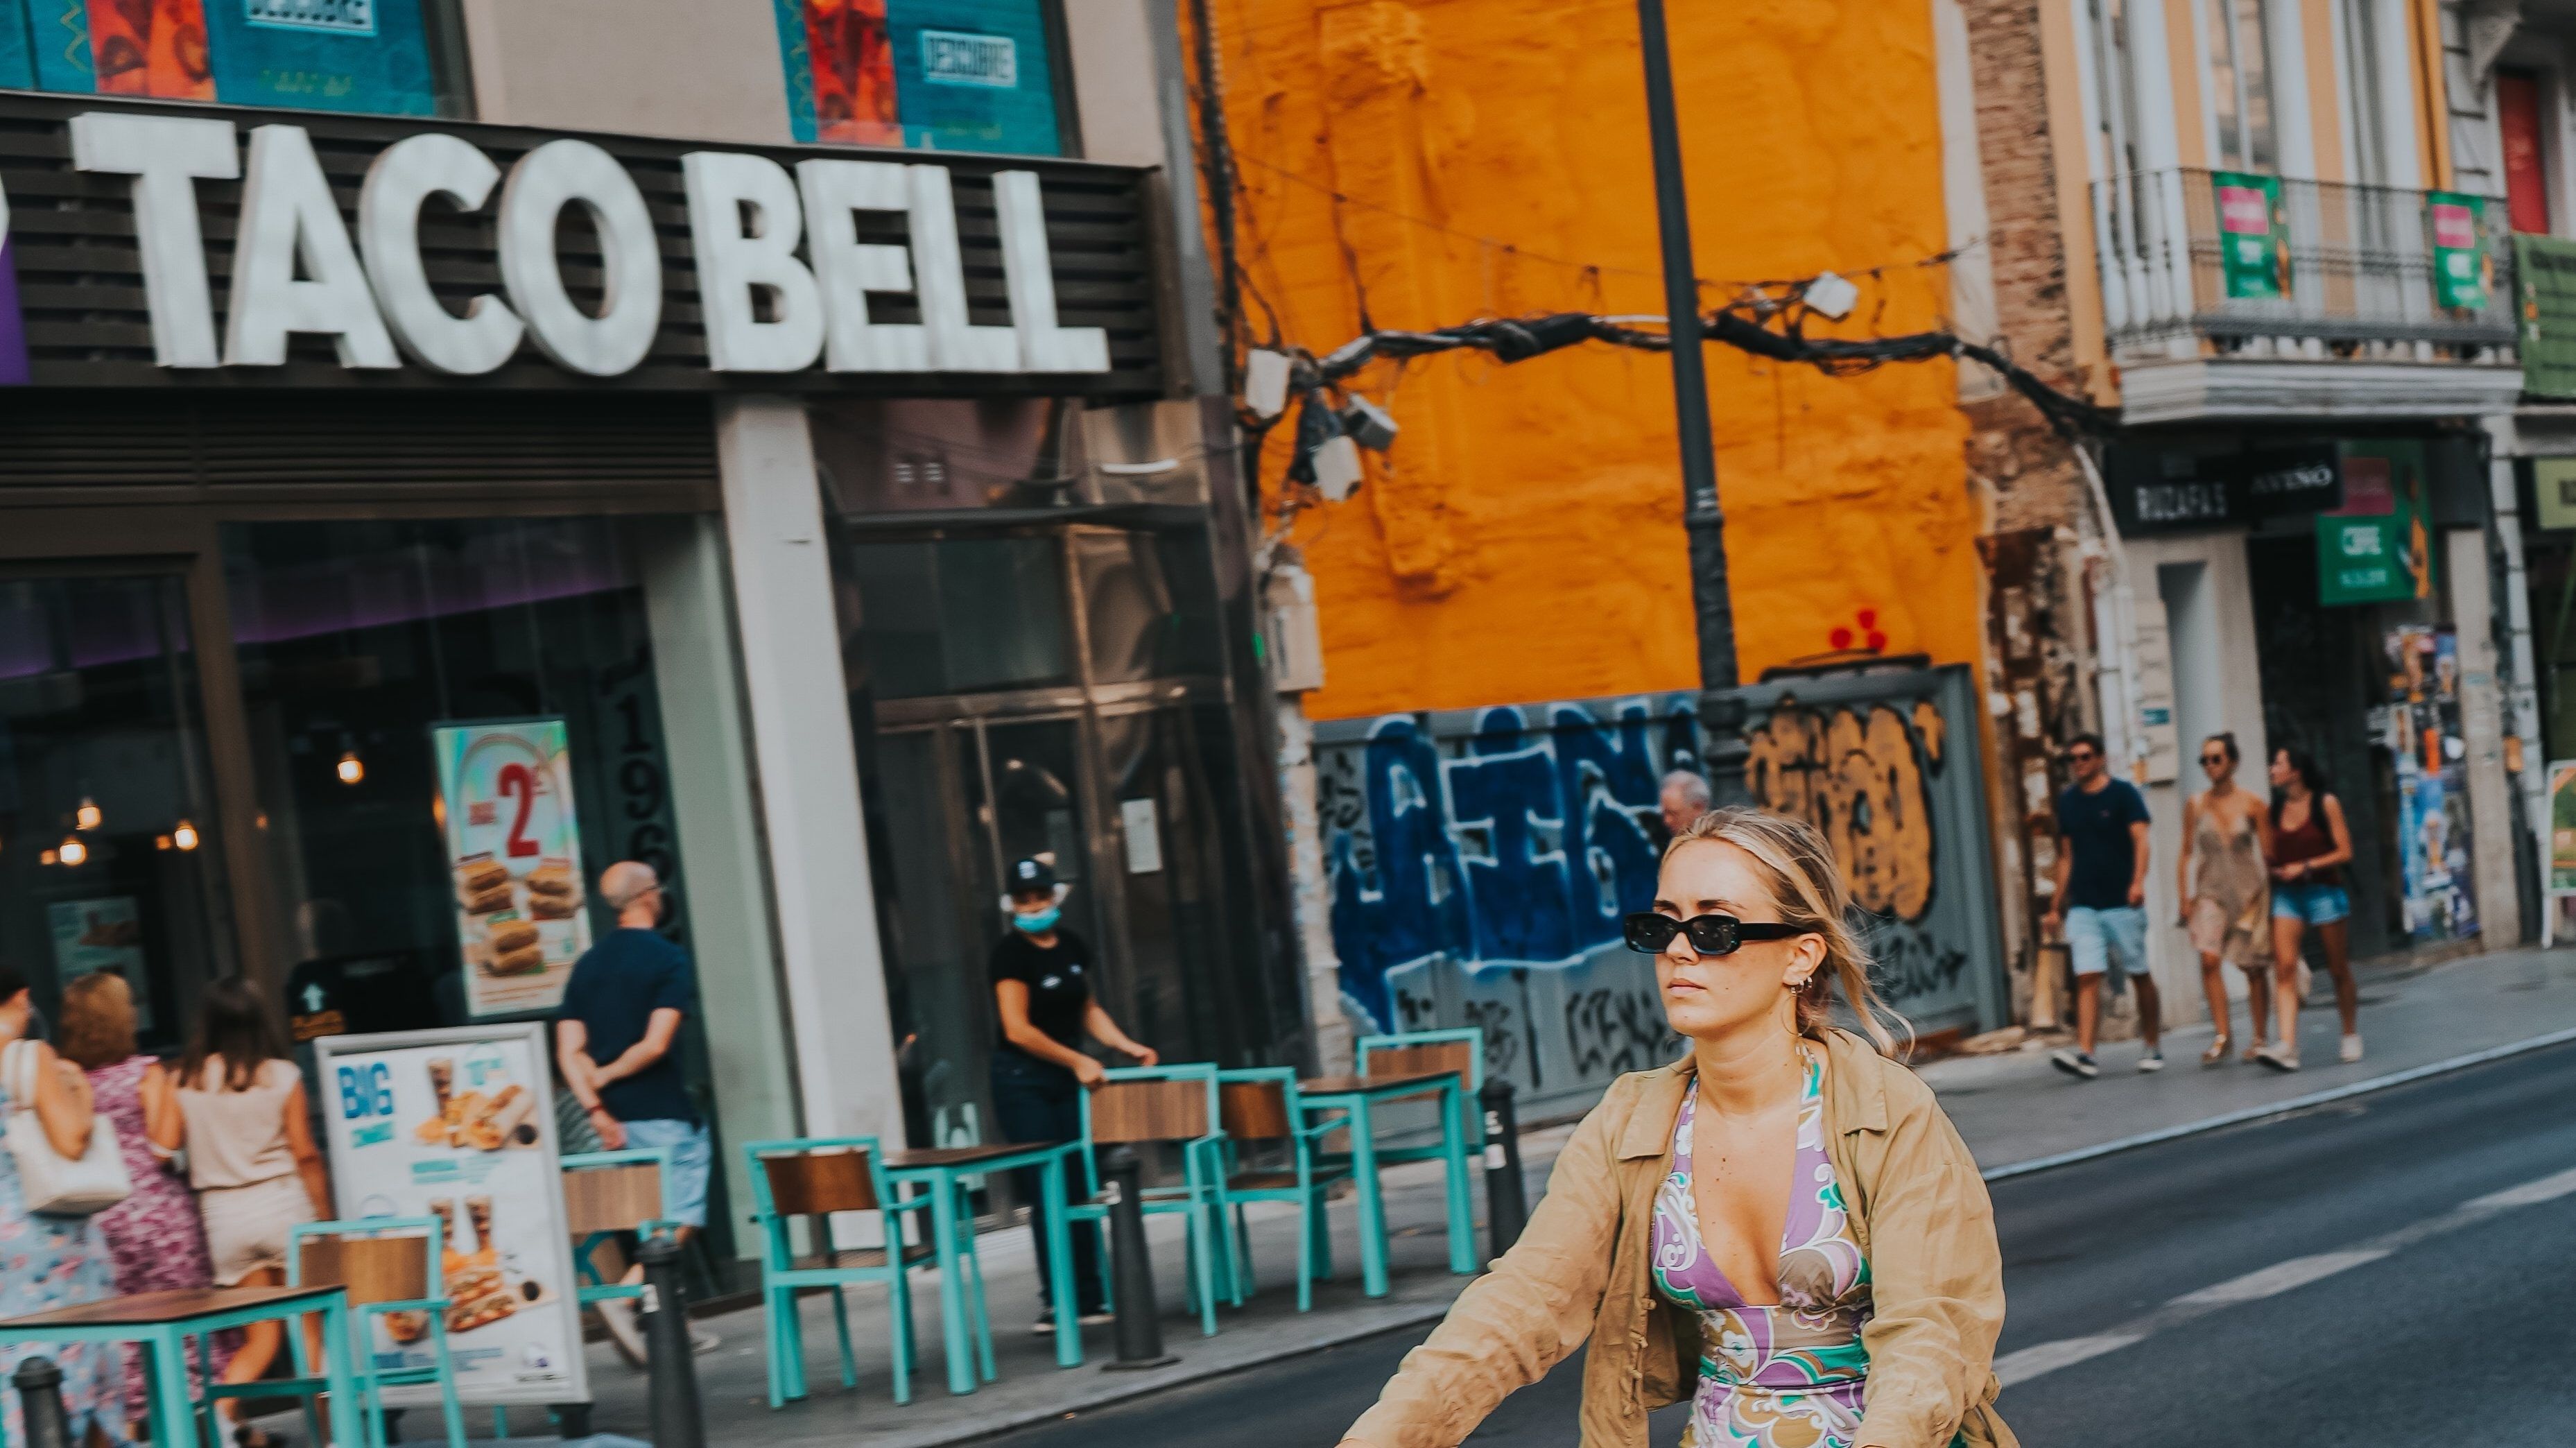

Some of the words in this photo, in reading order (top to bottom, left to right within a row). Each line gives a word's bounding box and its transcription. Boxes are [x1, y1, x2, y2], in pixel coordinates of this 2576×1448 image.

[69, 112, 662, 377] TACO
[682, 151, 1111, 374] BELL
[338, 1061, 395, 1120] BIG
